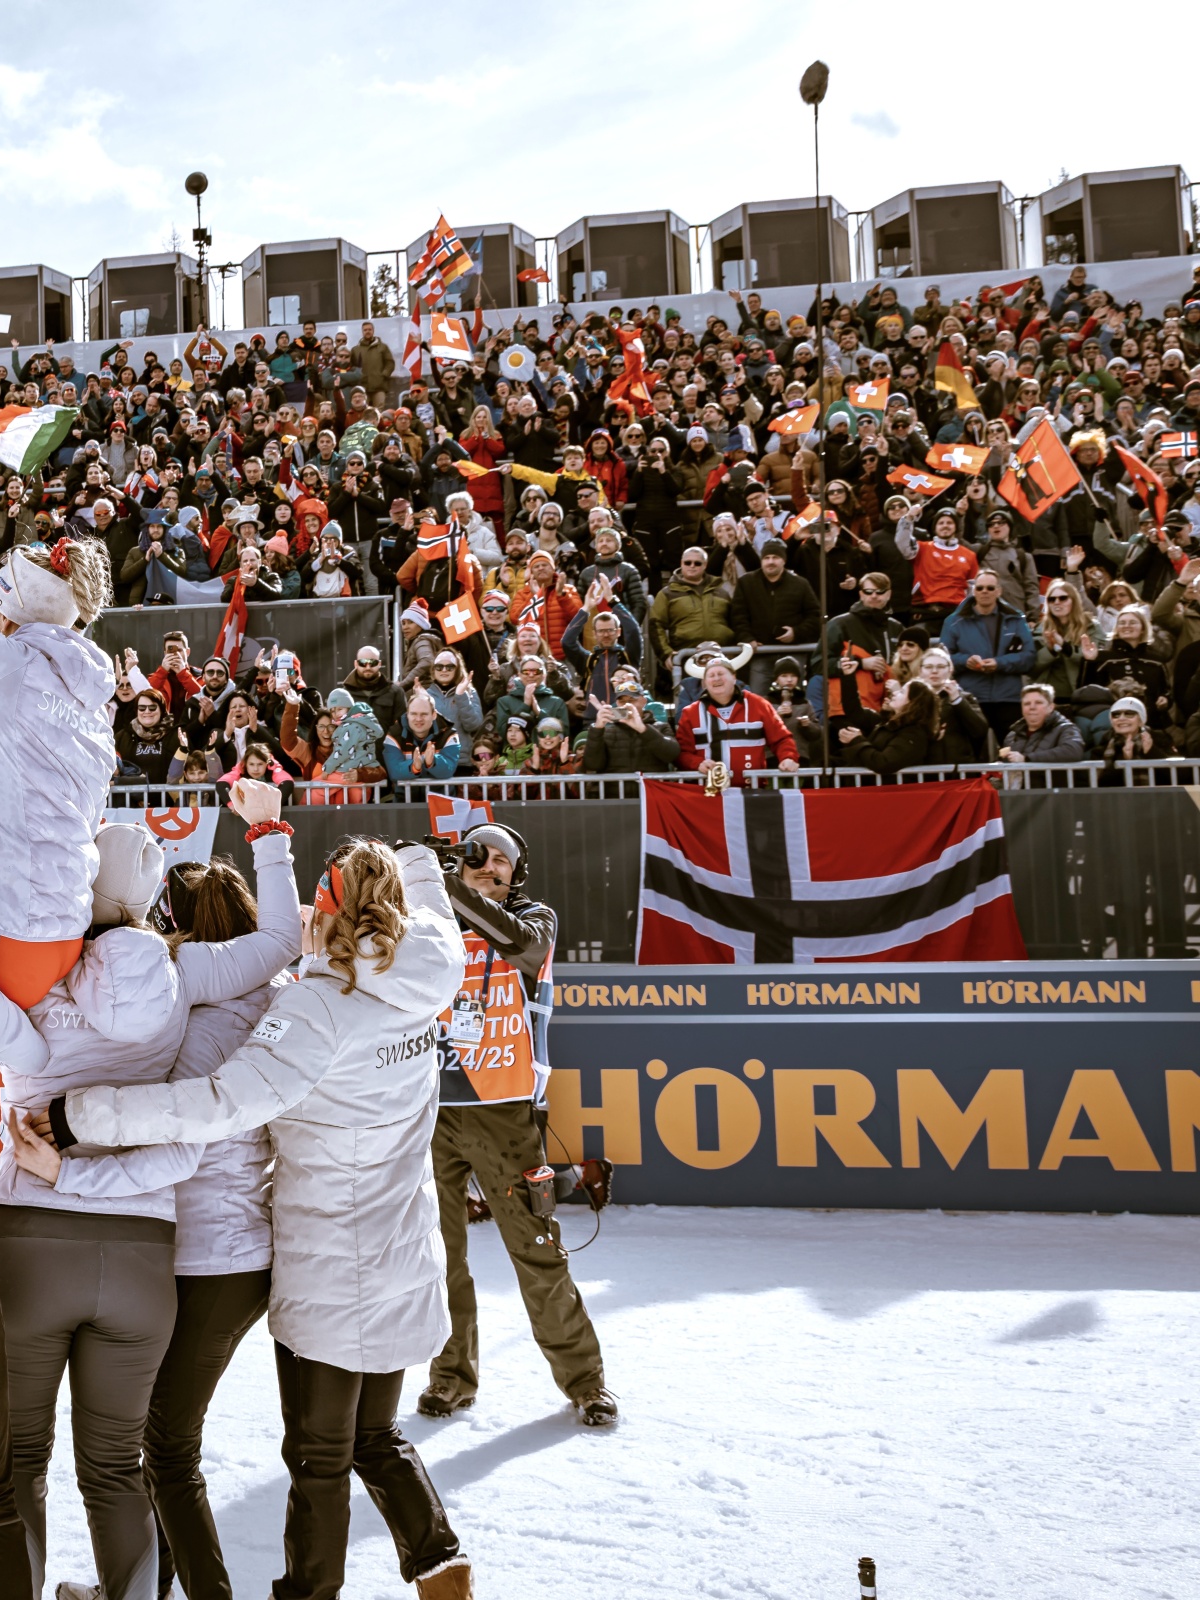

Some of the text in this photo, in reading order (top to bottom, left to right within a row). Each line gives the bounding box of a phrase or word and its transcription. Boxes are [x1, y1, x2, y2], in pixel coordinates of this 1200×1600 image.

[746, 981, 921, 1006] HÖRMANN
[962, 979, 1146, 1004] HÖRMANN
[255, 1031, 278, 1041] OPEL
